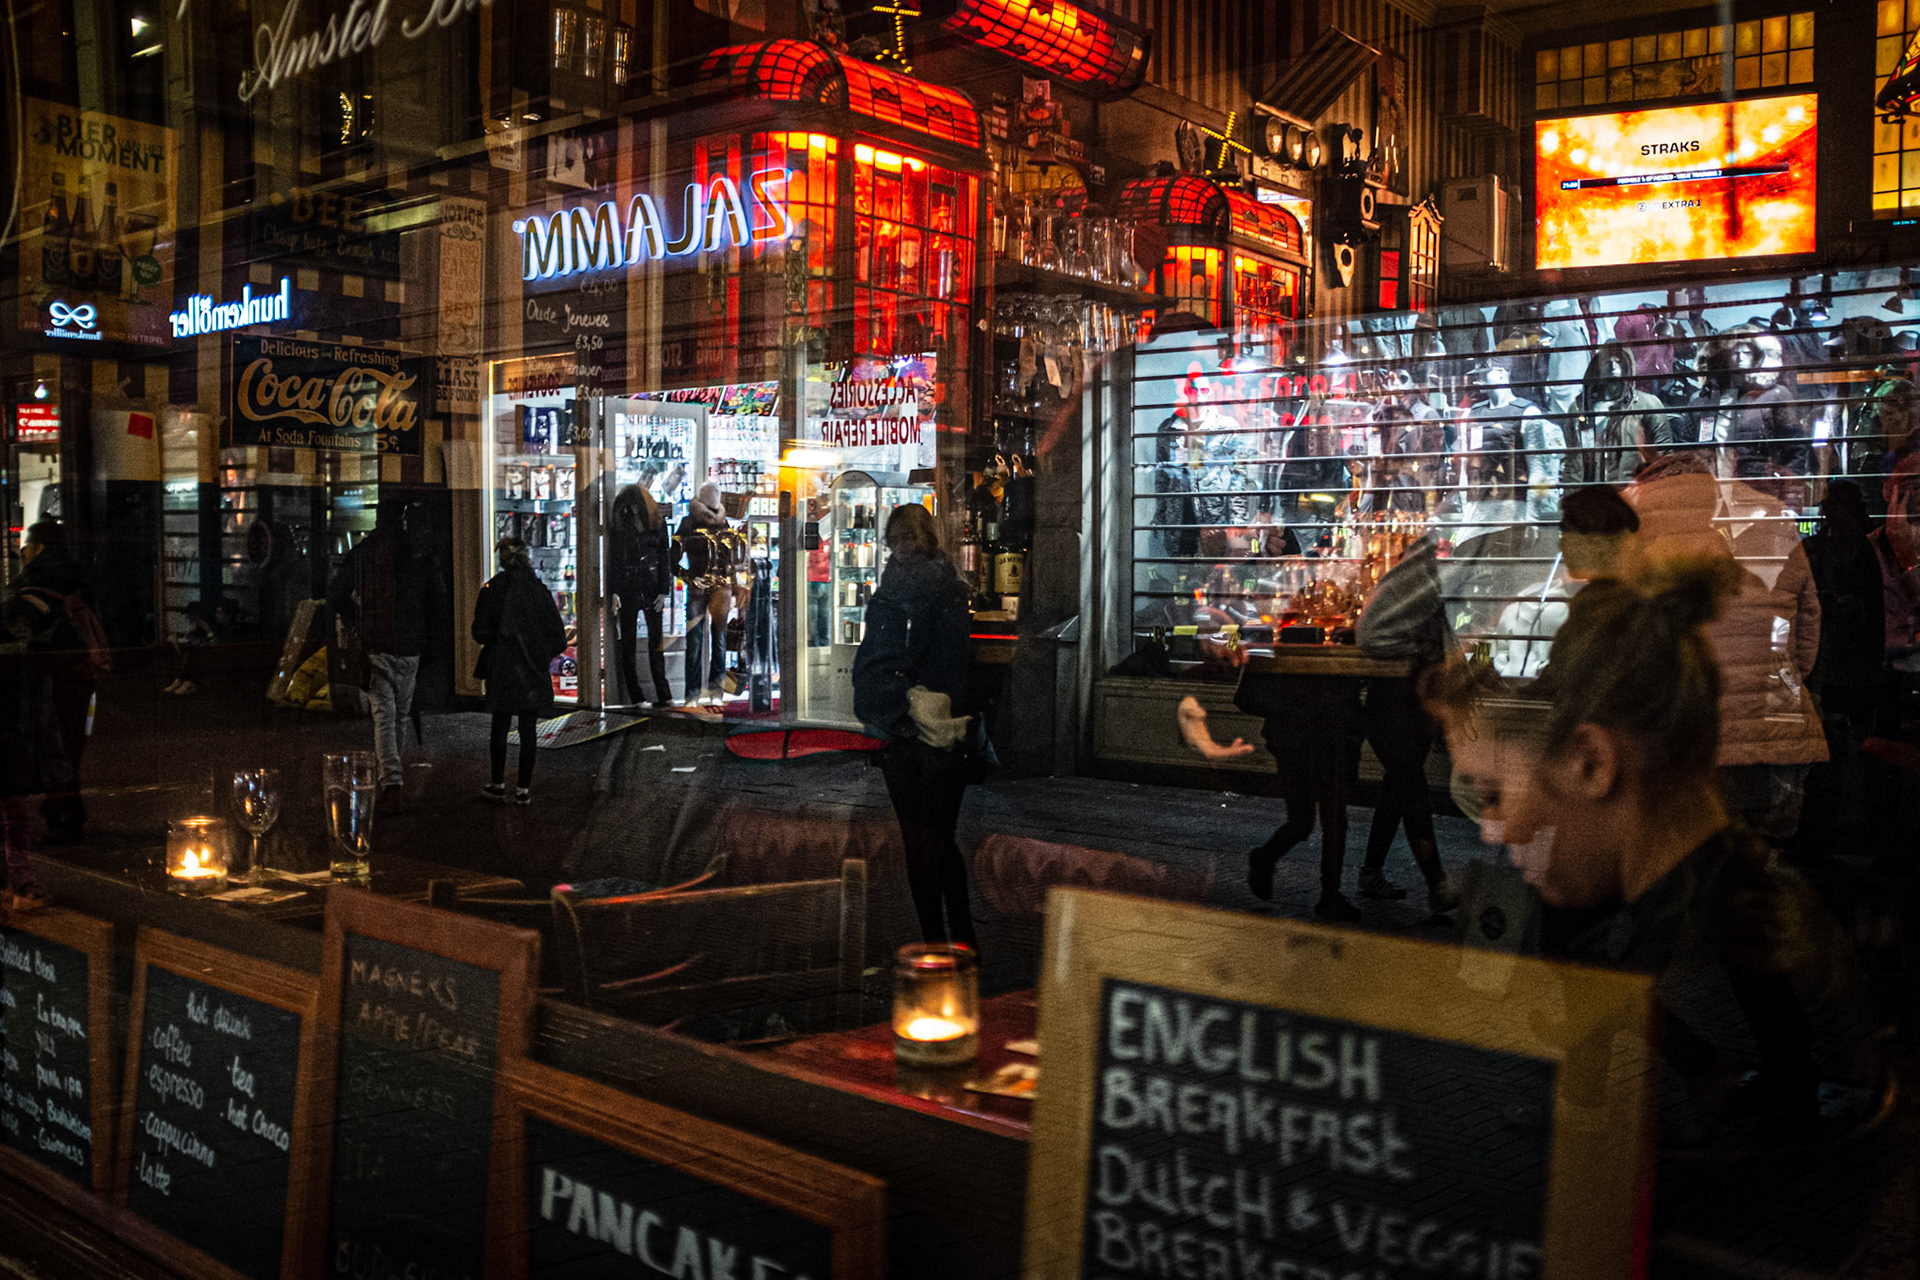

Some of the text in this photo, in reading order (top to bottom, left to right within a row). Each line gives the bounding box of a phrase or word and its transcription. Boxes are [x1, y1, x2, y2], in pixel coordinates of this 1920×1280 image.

[57, 114, 117, 145] BIER
[57, 135, 165, 174] MOMENT
[1641, 140, 1700, 156] STRAKS
[440, 204, 484, 230] NOTICE
[1662, 200, 1694, 210] EXTRA
[526, 299, 557, 323] Oude
[260, 339, 400, 371] Delicious Refreshing
[437, 368, 479, 388] LEAST
[237, 357, 418, 432] Coca-Cola
[436, 387, 480, 402] BE FUNNY
[258, 428, 272, 444] At
[275, 428, 304, 445] Soda
[308, 430, 361, 448] Fountains
[232, 1055, 254, 1099] tea
[227, 1097, 248, 1132] hot
